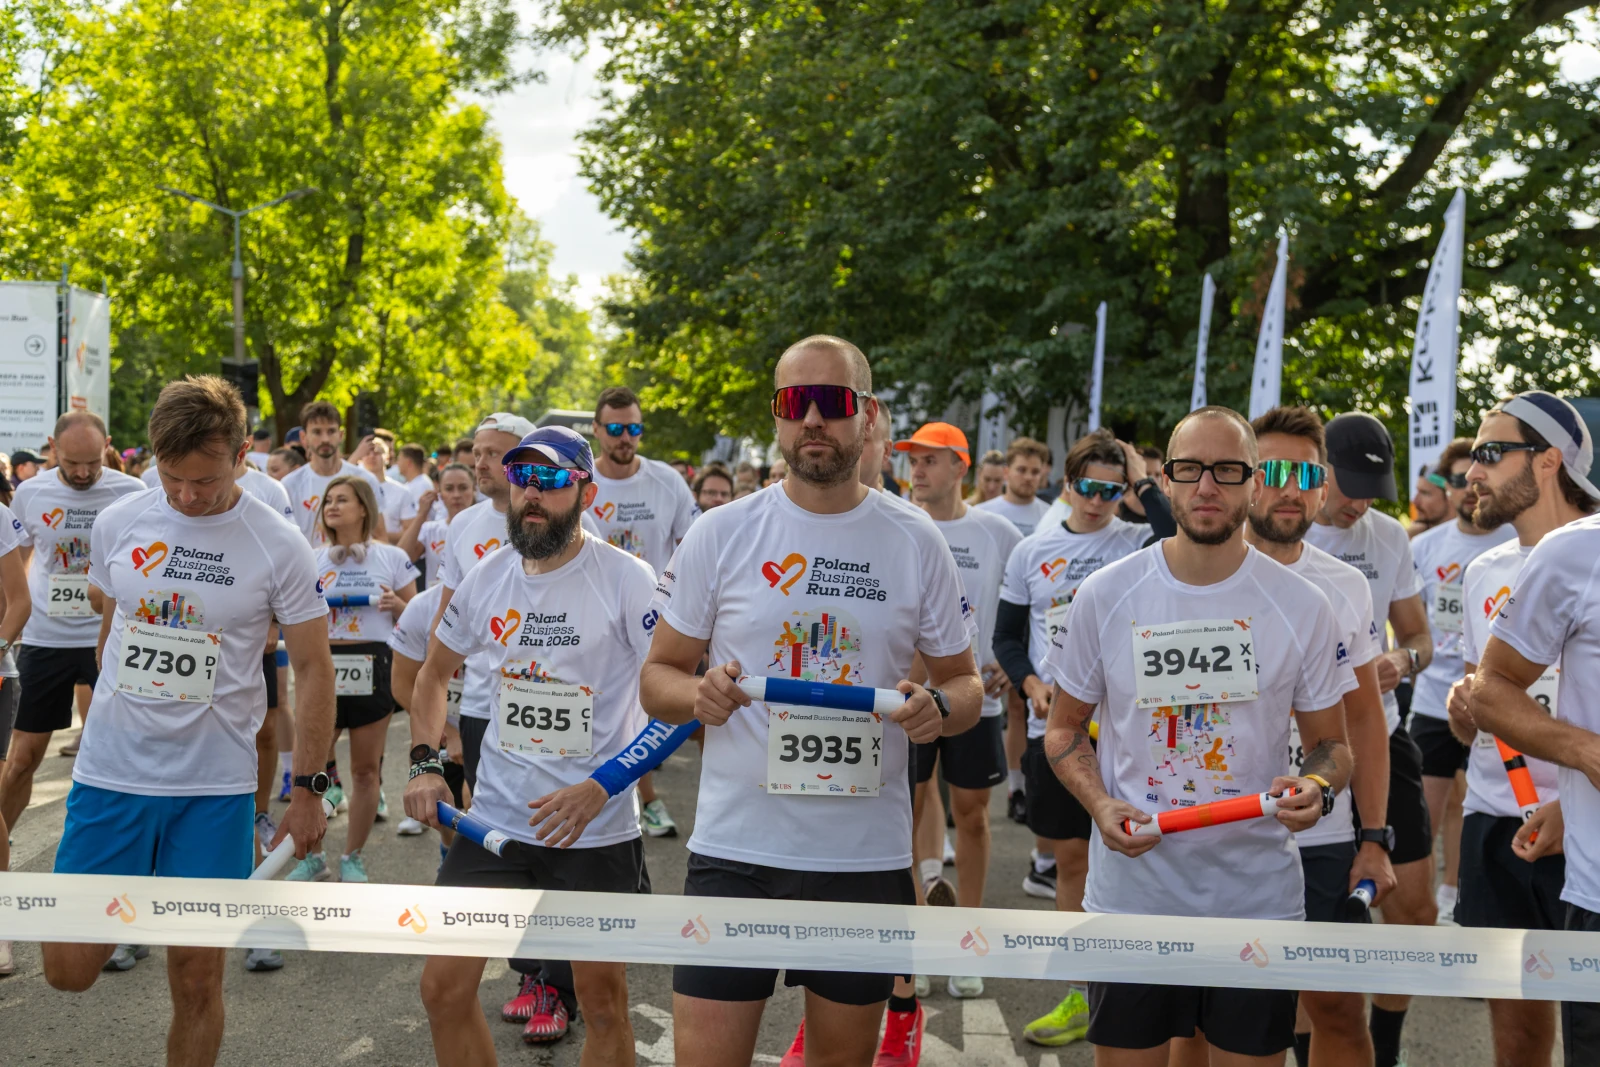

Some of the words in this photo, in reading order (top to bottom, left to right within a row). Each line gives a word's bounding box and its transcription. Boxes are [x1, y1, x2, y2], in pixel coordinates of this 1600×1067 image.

[66, 508, 98, 516] Poland
[65, 515, 97, 523] Busine
[64, 522, 82, 530] Run
[83, 522, 94, 530] 20
[172, 546, 224, 562] Poland
[948, 545, 969, 554] land
[167, 557, 230, 575] Business
[813, 557, 870, 573] Poland
[162, 567, 192, 580] Run
[195, 572, 235, 586] 2026
[809, 569, 880, 588] Business
[51, 588, 86, 602] 294
[806, 583, 840, 597] Run
[844, 586, 887, 602] 2026
[1438, 598, 1463, 614] 36
[525, 612, 567, 623] Poland
[521, 623, 575, 635] Business
[518, 635, 544, 646] Run
[546, 635, 580, 646] 2026
[1240, 643, 1252, 656] X
[125, 645, 196, 677] 2730
[205, 656, 216, 667] D
[1143, 645, 1233, 677] 3942
[1243, 659, 1251, 671] 1
[205, 669, 212, 680] 1
[506, 702, 571, 732] 2635
[581, 708, 591, 719] C
[789, 713, 813, 721] Poland
[813, 713, 841, 722] Business
[582, 722, 588, 732] 1
[616, 721, 679, 770] THLON
[779, 734, 862, 764] 3935
[871, 737, 881, 750] X
[873, 754, 879, 766] 1
[1146, 793, 1159, 801] GLS
